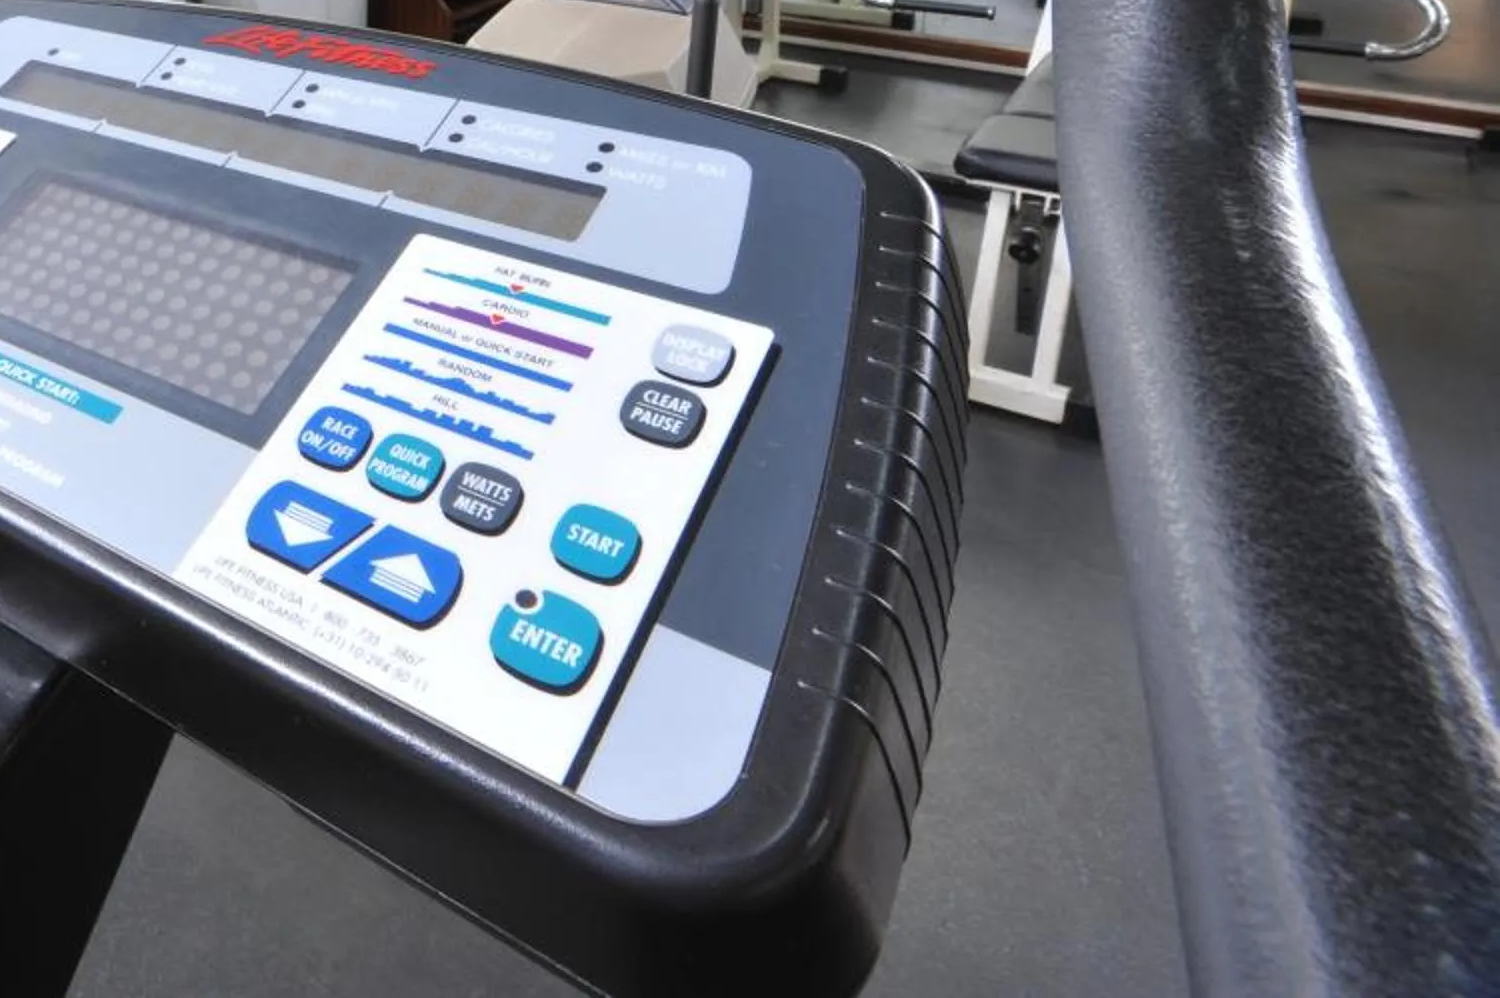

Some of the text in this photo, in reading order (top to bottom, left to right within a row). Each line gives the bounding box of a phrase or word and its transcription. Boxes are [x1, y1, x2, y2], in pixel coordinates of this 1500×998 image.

[483, 299, 530, 318] CARDIO
[413, 317, 457, 339] MANUAL
[475, 337, 512, 355] QUICK
[514, 350, 554, 368] START
[438, 358, 493, 382] RANDOM
[643, 389, 693, 416] CLEAR
[321, 416, 360, 440] RACE
[630, 408, 684, 436] PAUSE
[301, 430, 356, 462] ON/OFF
[389, 443, 431, 468] QUICK
[367, 458, 431, 491] PROGRAM
[462, 470, 513, 502] WATTS
[453, 494, 497, 523] METS
[566, 522, 625, 558] START
[508, 618, 584, 669] ENTER
